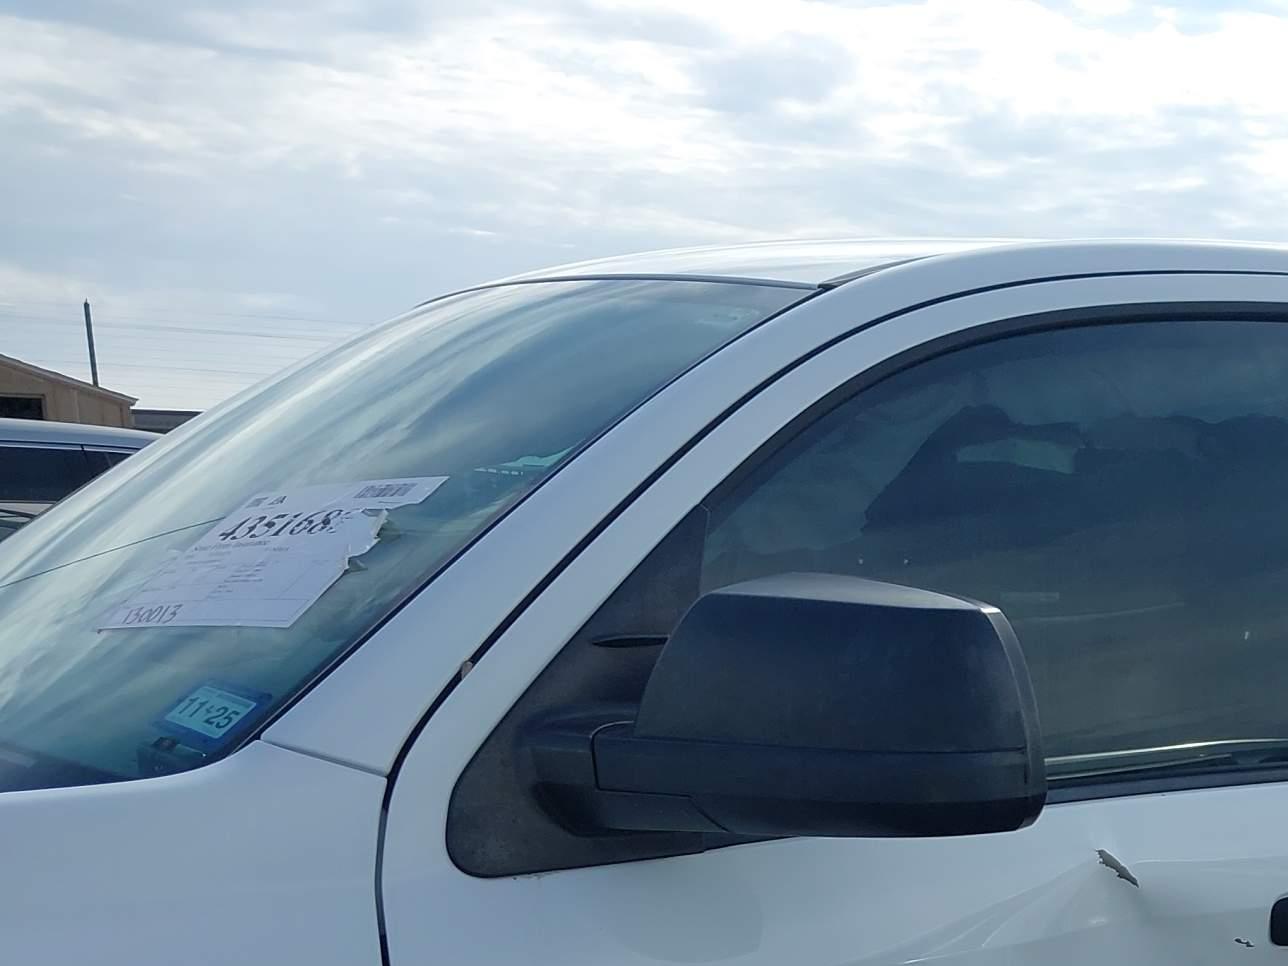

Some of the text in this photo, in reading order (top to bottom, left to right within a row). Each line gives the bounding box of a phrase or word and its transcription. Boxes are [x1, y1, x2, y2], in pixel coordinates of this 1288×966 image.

[219, 509, 352, 541] 435168
[178, 696, 241, 729] 11 25
